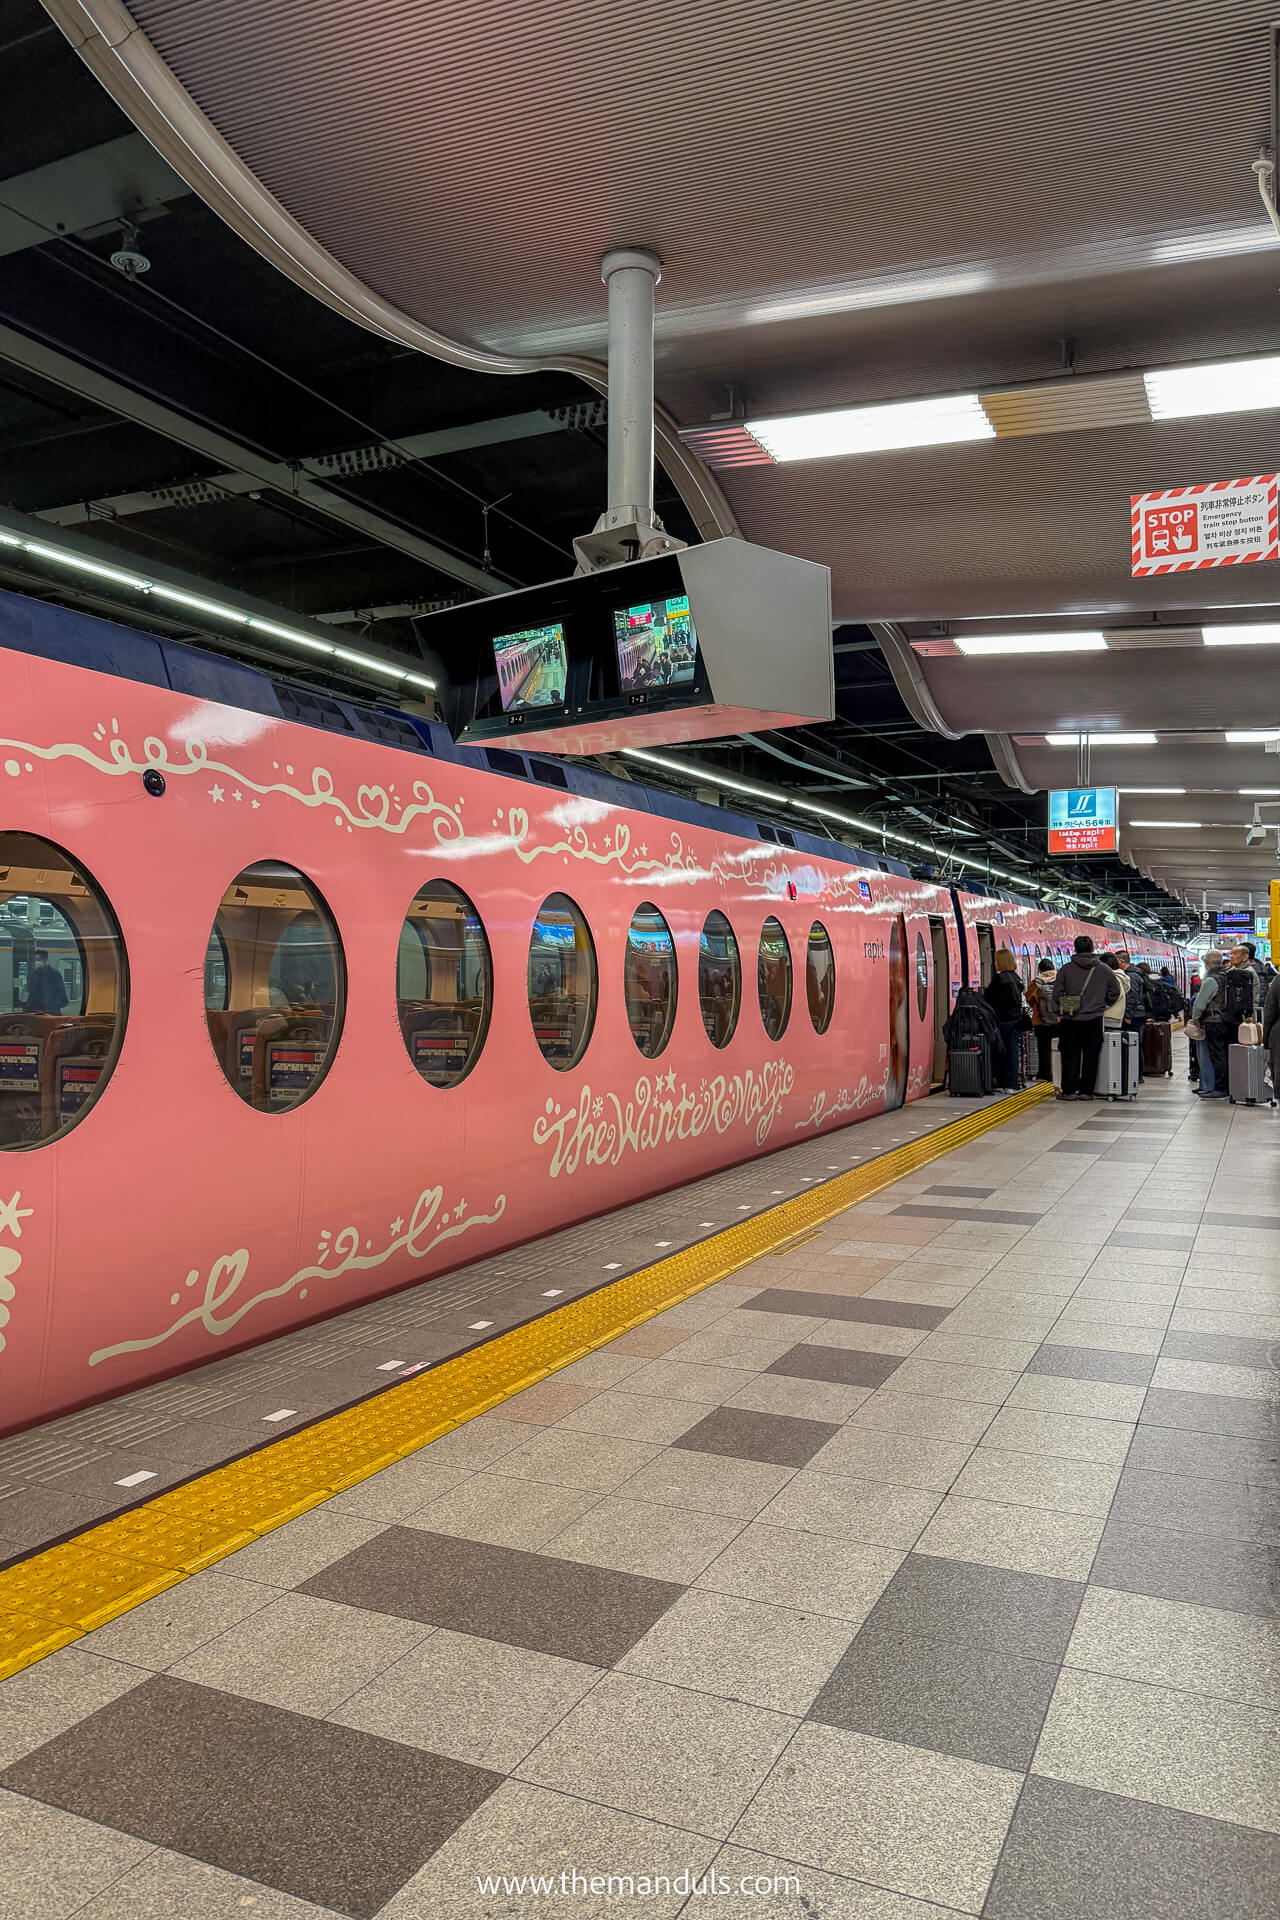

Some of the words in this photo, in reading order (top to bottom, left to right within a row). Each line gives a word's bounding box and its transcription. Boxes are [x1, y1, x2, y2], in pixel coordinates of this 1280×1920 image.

[1200, 494, 1265, 511] 列車非常停止ボタン
[1148, 510, 1195, 527] STOP
[1203, 511, 1242, 521] Emergency
[1239, 515, 1264, 523] button
[1202, 912, 1209, 920] 9
[533, 1085, 616, 1178] The
